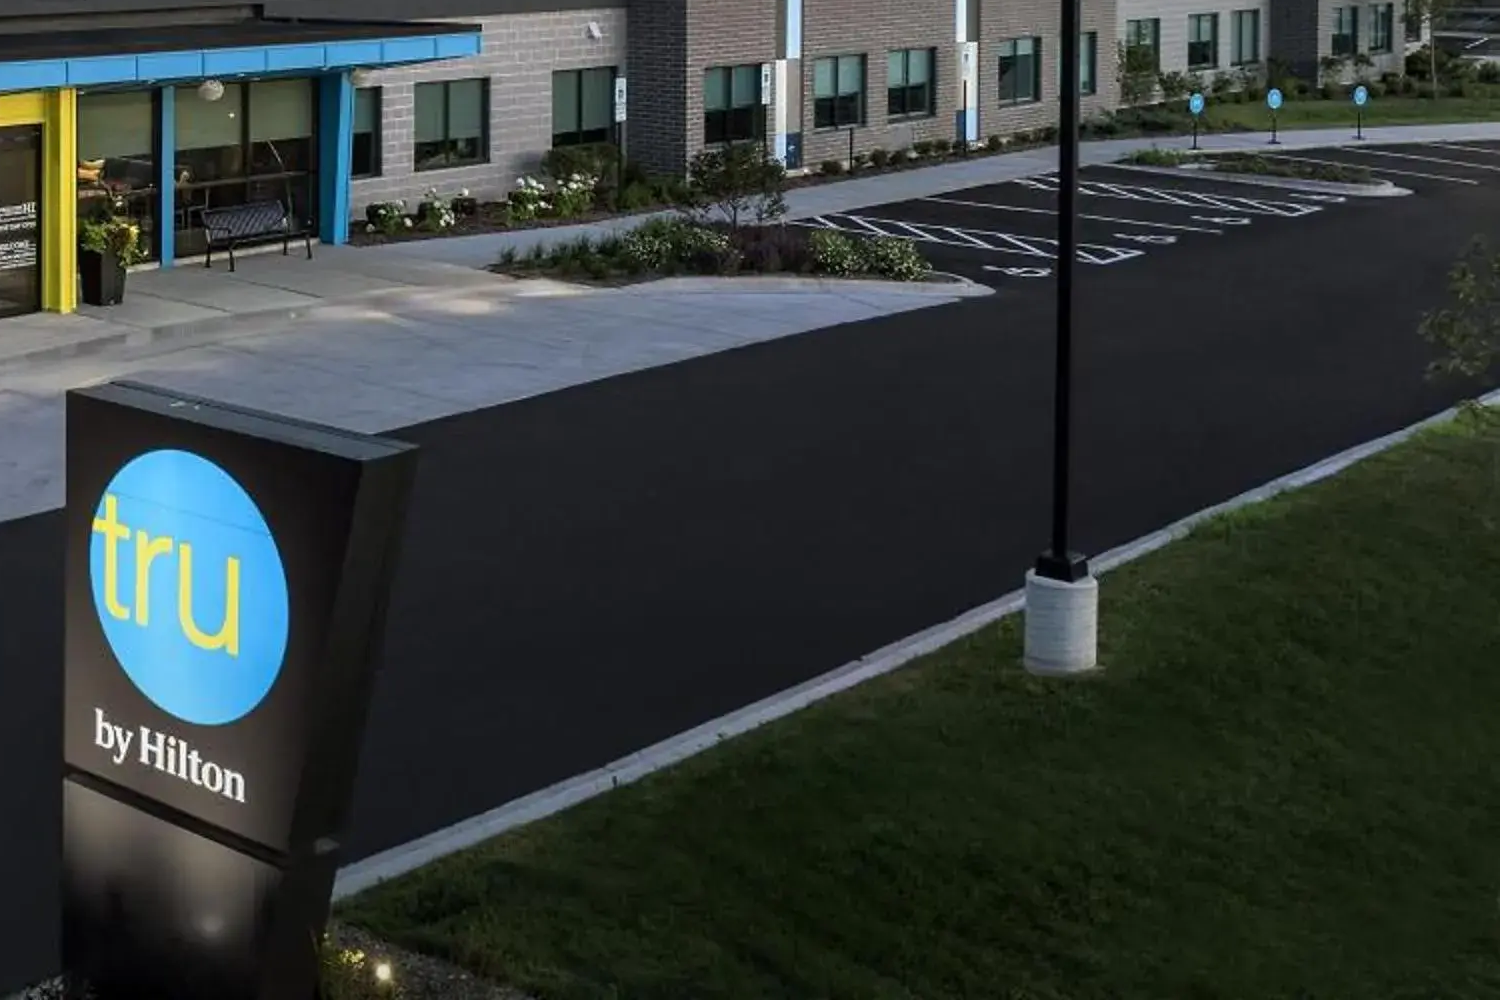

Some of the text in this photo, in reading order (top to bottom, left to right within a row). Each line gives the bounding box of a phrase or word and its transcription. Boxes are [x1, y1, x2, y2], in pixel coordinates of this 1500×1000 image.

[92, 492, 241, 658] tru
[94, 708, 246, 803] by Hilton
